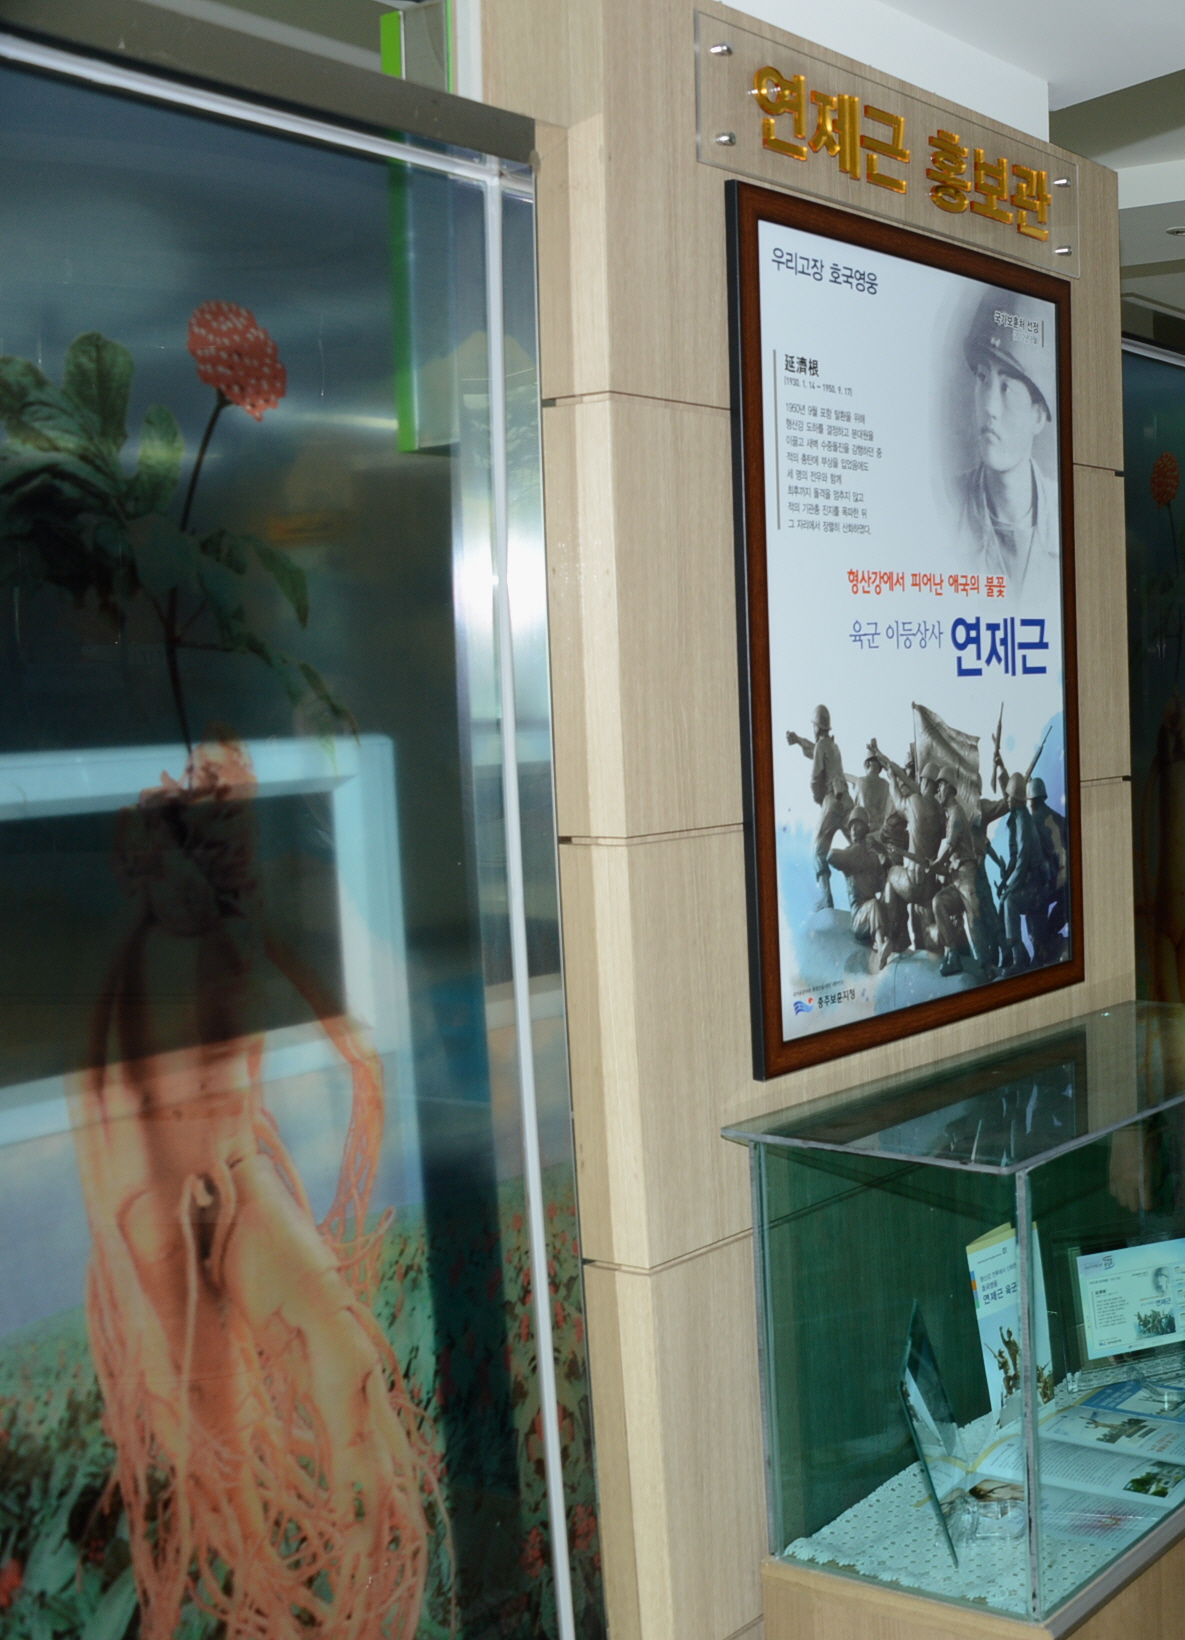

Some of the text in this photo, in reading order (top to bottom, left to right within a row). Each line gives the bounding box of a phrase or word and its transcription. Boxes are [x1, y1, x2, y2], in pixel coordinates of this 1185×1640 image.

[753, 66, 1051, 242] 연제근 홍보관
[771, 247, 878, 295] 우리고장 호국영웅
[994, 310, 1039, 334] 국가보훈처 선정
[784, 353, 819, 378] 延濟根
[786, 403, 806, 416] 1950년
[820, 407, 832, 420] 포항
[785, 418, 804, 432] 형산강
[806, 421, 824, 435] 도하를
[786, 451, 799, 464] 적의
[821, 456, 838, 469] 부상을
[787, 468, 794, 480] 세
[788, 501, 800, 513] 적의
[788, 519, 795, 528] 그
[847, 569, 1006, 598] 형산강에서 피어난 애국의 불꽃
[849, 616, 1049, 677] 육군 이등상사 연제근
[817, 988, 856, 1009] 충주보훈지청
[983, 1281, 1018, 1305] 연제근 육군
